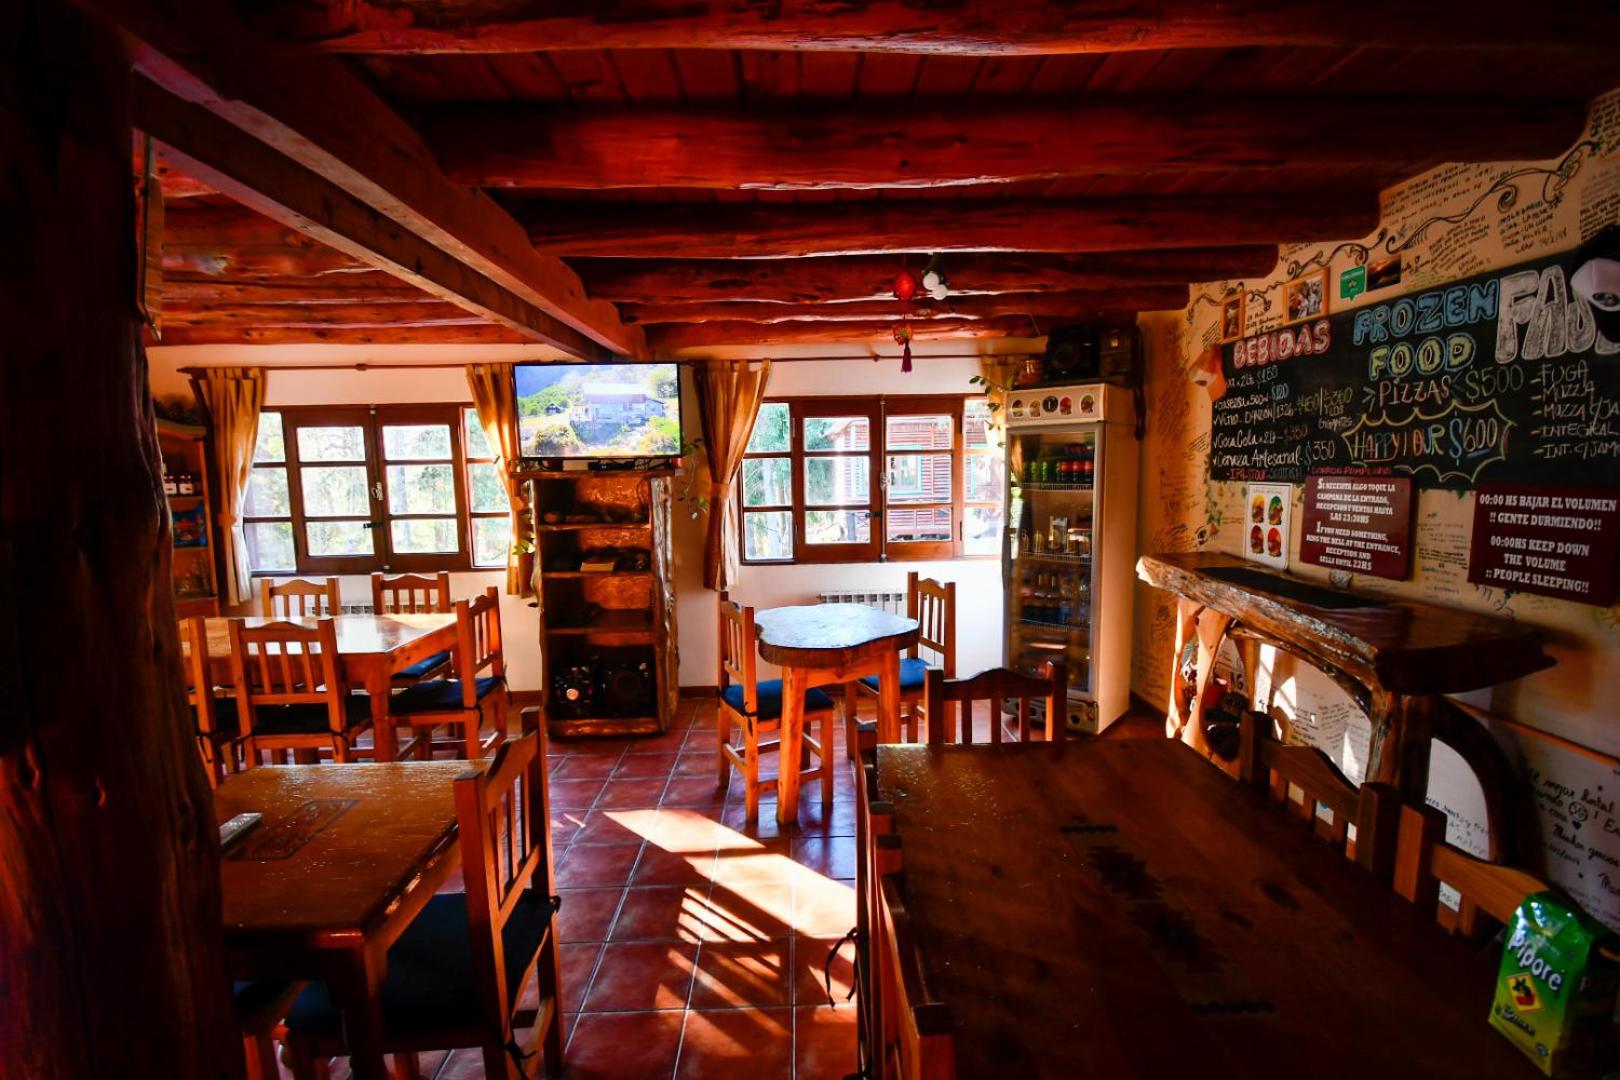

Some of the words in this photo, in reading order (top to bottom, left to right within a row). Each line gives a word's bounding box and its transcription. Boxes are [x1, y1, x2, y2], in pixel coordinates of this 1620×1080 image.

[1353, 278, 1500, 346] FROZEN
[1233, 319, 1332, 369] BEBIDAS
[1368, 332, 1476, 381] FOOD
[1465, 363, 1525, 403] $500
[1538, 359, 1590, 388] FUGA
[1352, 431, 1400, 461] HAPPY
[1449, 411, 1498, 466] $600
[1304, 440, 1336, 470] $350
[1352, 482, 1367, 491] ALGO
[1368, 483, 1387, 492] TOQUE
[1387, 484, 1396, 492] LA
[1316, 493, 1343, 501] CAMPANA
[1352, 494, 1359, 502] LA
[1479, 494, 1504, 506] 00:00
[1504, 494, 1517, 506] HS
[1519, 496, 1550, 510] BAJAR
[1551, 497, 1564, 509] EL
[1565, 498, 1617, 512] VOLUMEN
[1330, 513, 1342, 521] LAS
[1498, 512, 1529, 526] GENTE
[1530, 515, 1602, 531] DURMIENDO!!
[1335, 527, 1350, 536] NEED
[1320, 536, 1331, 544] THE
[1331, 537, 1345, 546] BELL
[1346, 539, 1353, 547] AT
[1354, 540, 1365, 549] THE
[1528, 539, 1555, 553] KEEP
[1556, 542, 1590, 557] DOWN
[1326, 546, 1358, 558] RECEPTION
[1359, 551, 1371, 560] AND
[1503, 553, 1523, 566] THE
[1525, 556, 1567, 572] VOLUME
[1493, 568, 1531, 584] PEOPLE
[1531, 573, 1589, 593] SLEEPING!!
